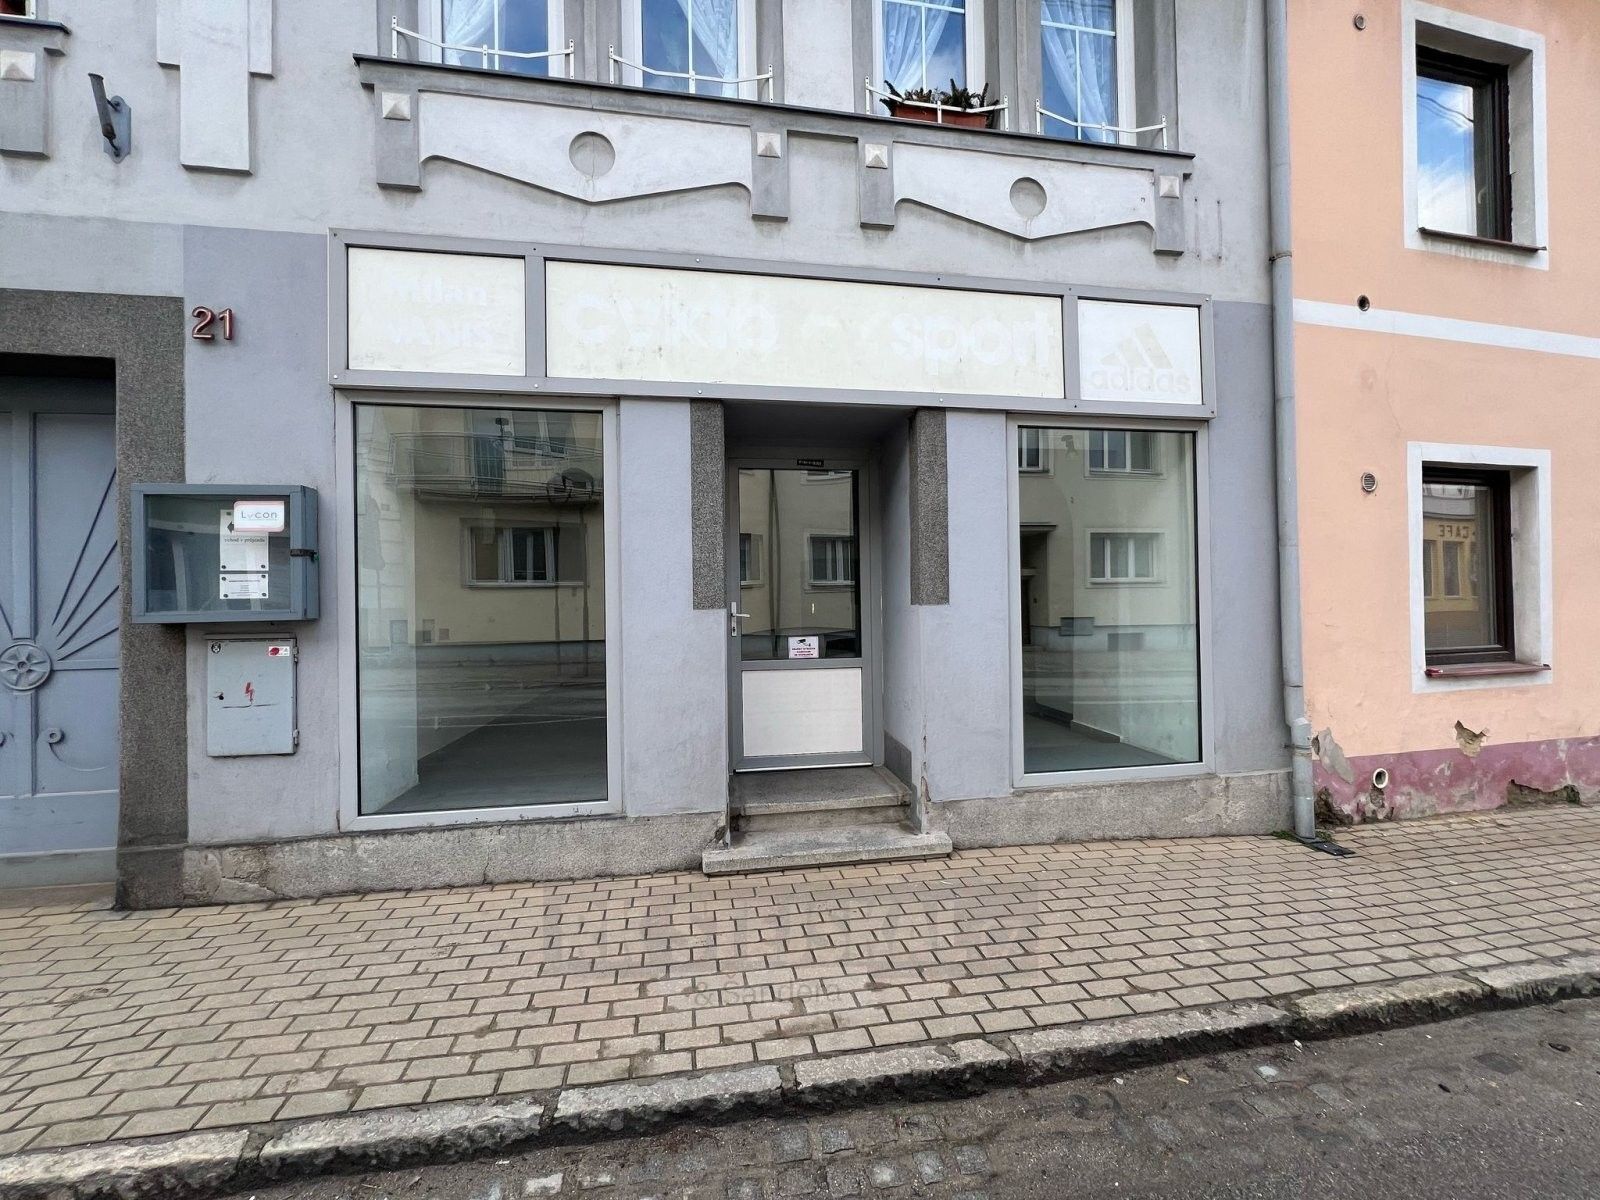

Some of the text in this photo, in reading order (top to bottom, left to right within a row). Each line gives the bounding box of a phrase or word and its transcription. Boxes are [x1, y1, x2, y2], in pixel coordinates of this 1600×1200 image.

[192, 306, 233, 340] 21
[890, 311, 1055, 376] sport
[1089, 366, 1191, 394] adidas
